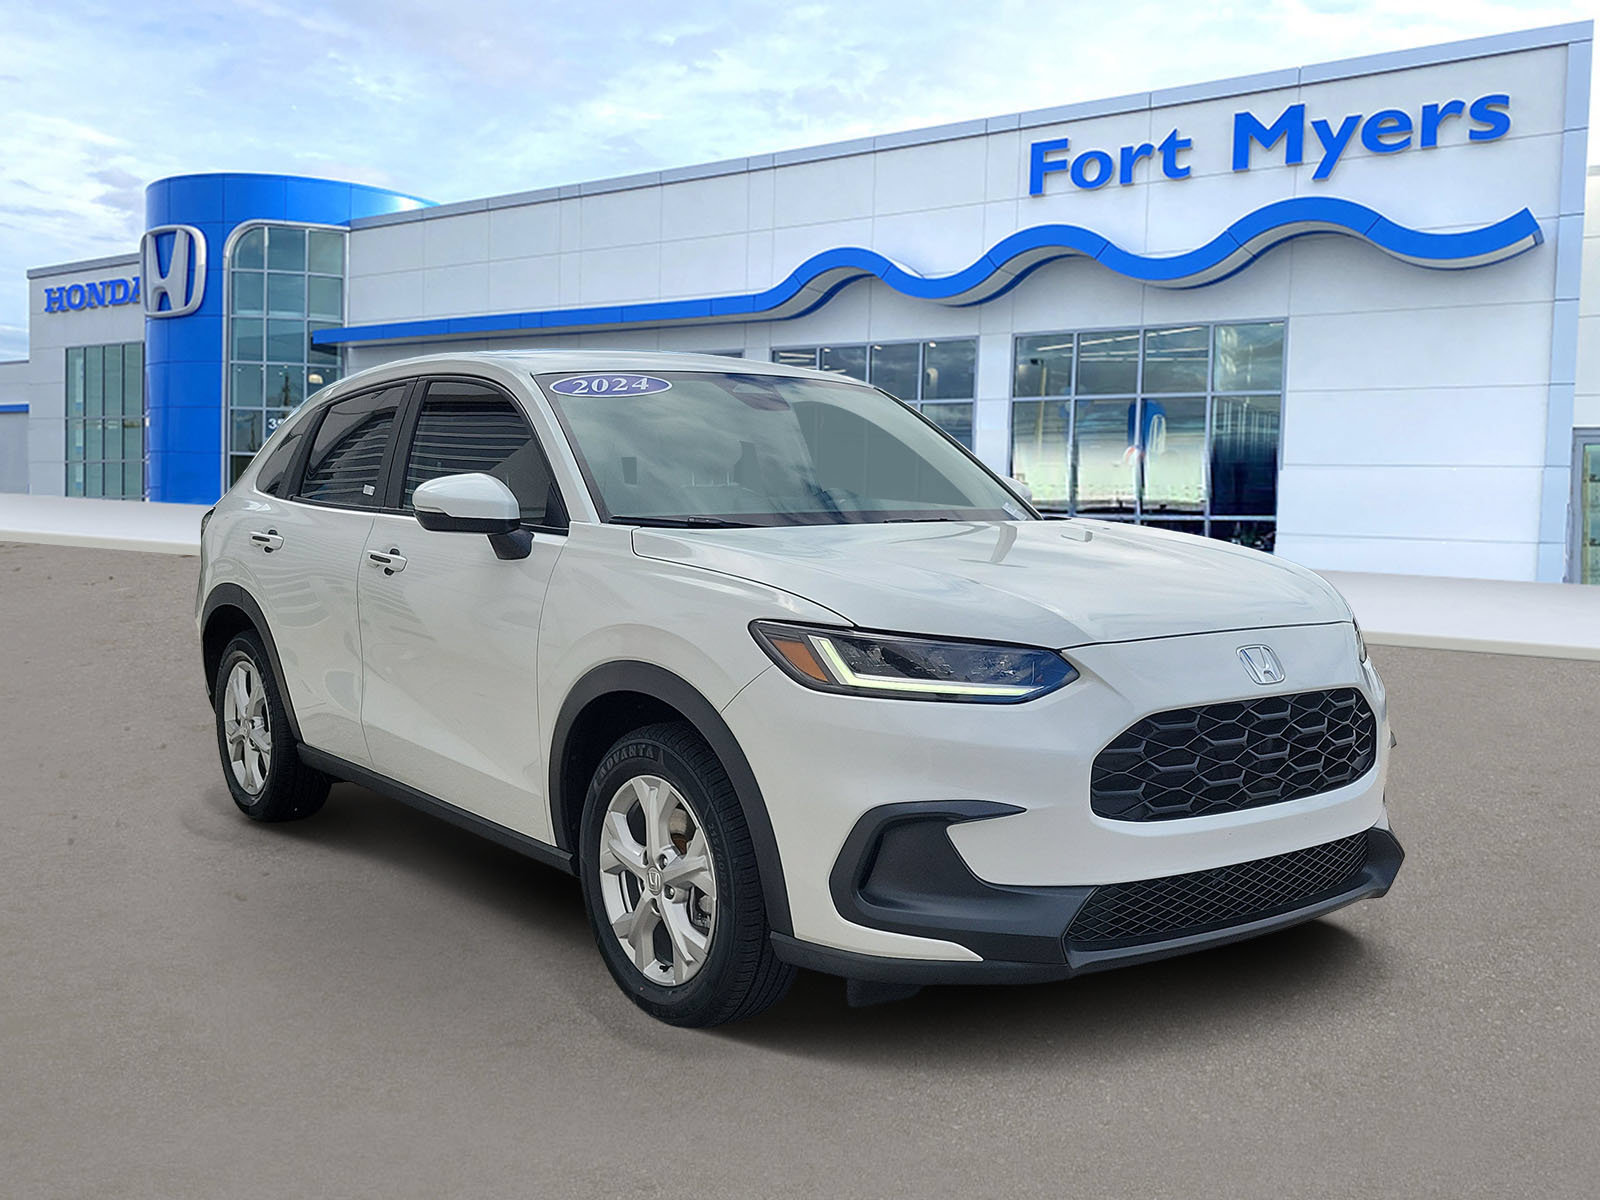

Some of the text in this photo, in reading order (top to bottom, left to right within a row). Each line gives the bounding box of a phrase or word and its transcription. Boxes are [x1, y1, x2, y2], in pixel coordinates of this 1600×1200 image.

[1028, 93, 1512, 197] Fort Myers
[572, 377, 650, 395] 2024
